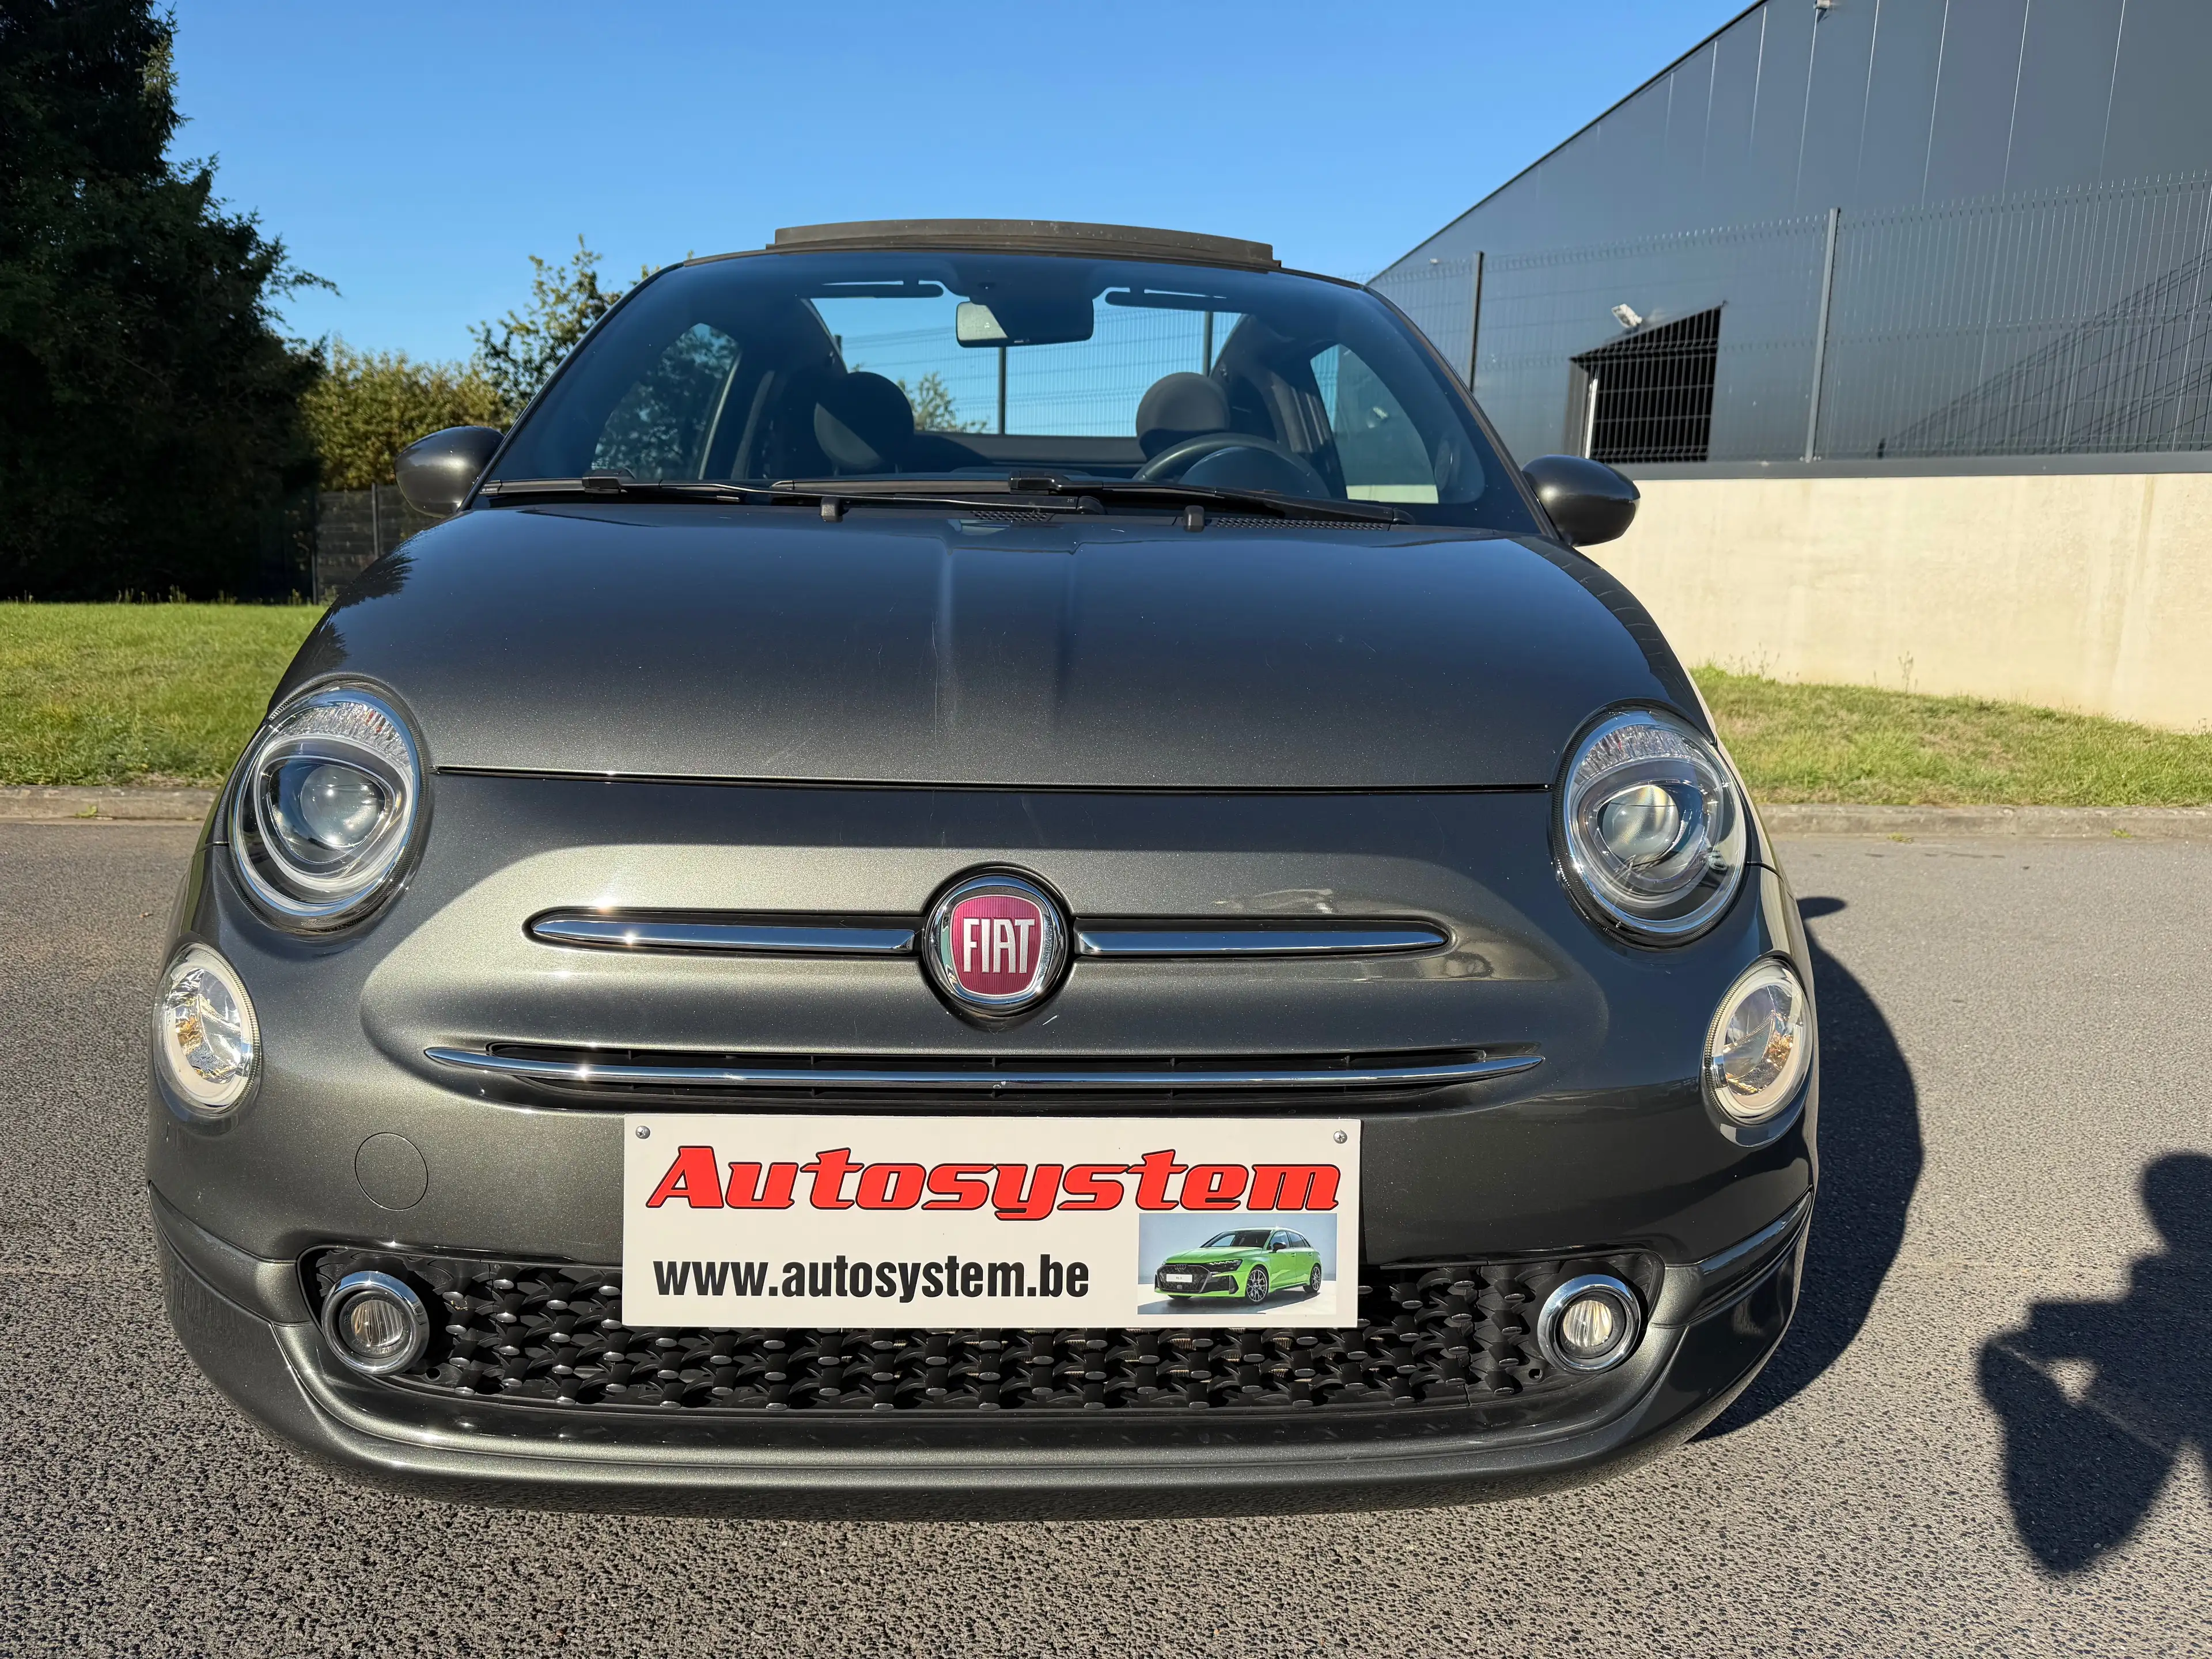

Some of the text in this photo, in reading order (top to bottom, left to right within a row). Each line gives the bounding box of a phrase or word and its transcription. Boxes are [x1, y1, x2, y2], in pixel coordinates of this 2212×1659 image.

[963, 917, 1035, 974] FIAT
[646, 1146, 1340, 1221] Autosystem
[653, 1254, 1088, 1303] www.autosystem.be
